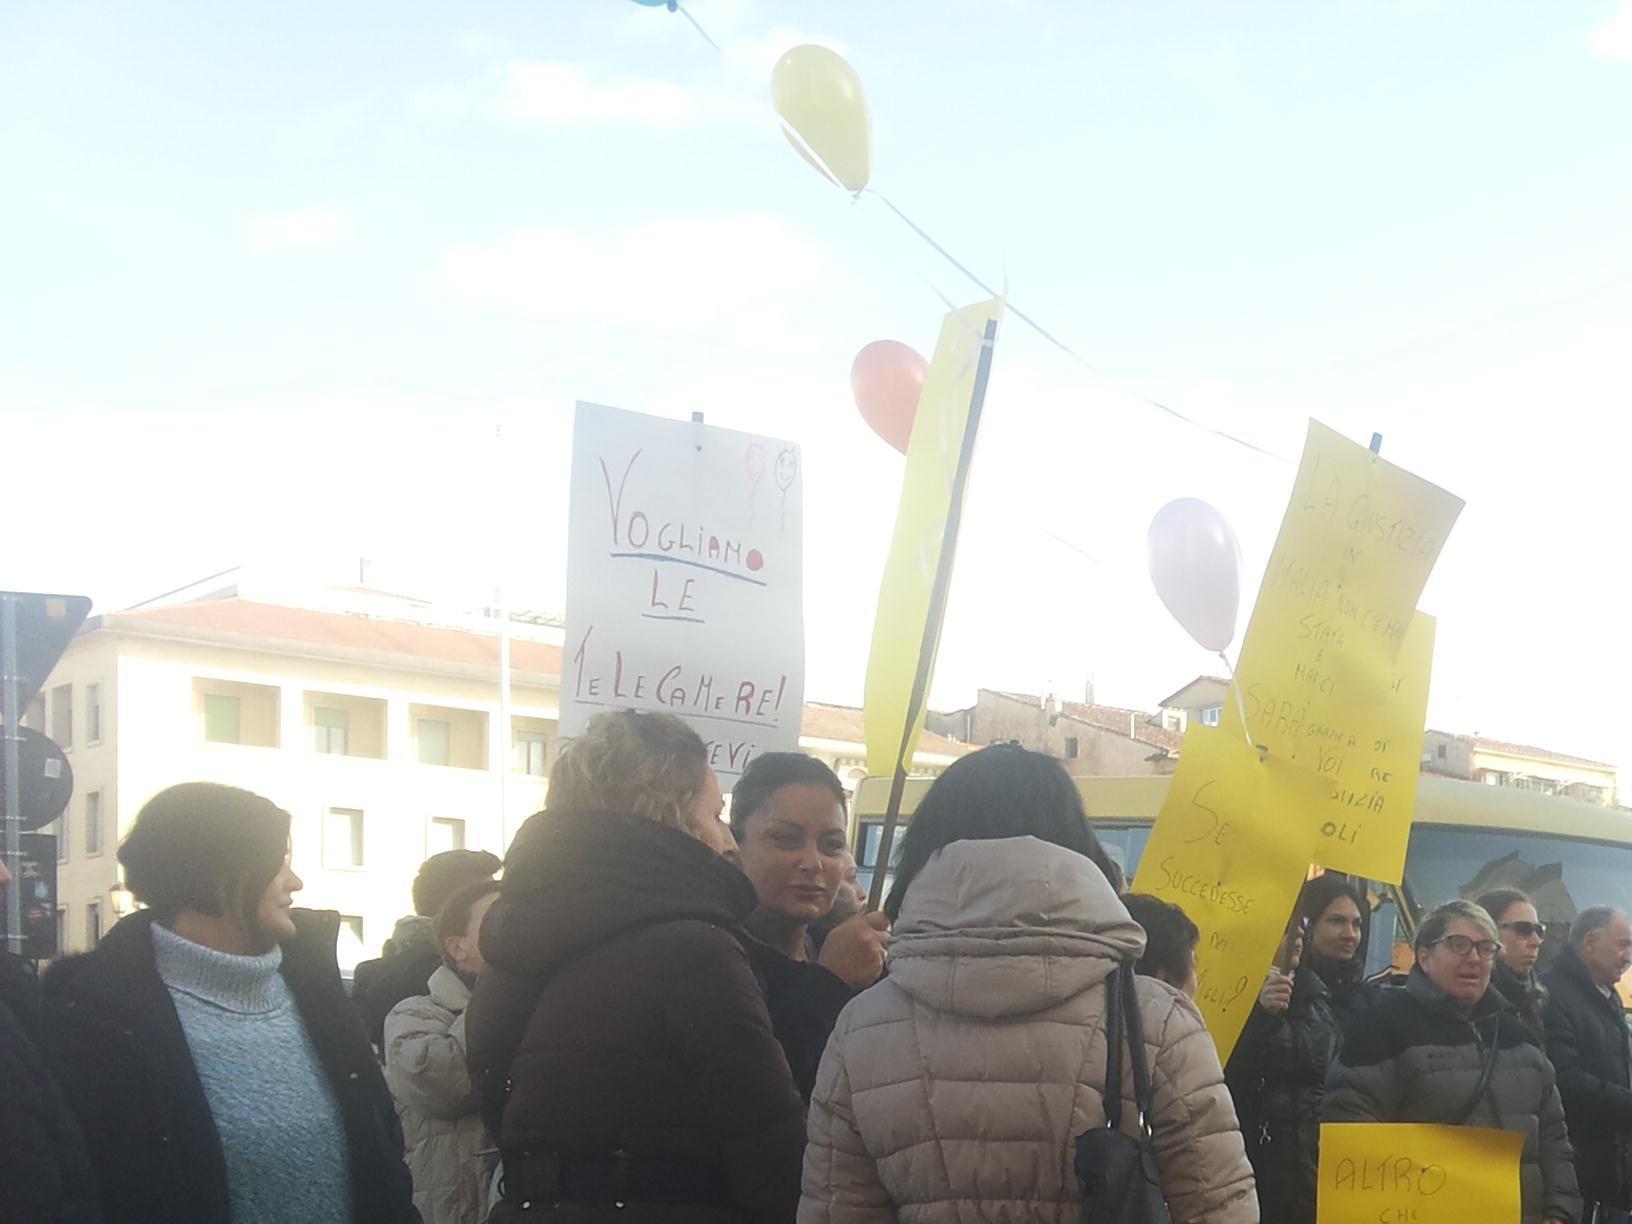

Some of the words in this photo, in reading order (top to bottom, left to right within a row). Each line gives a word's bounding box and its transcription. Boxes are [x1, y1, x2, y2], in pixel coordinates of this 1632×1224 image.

[599, 449, 765, 571] VOGLIAMO
[651, 569, 696, 612] LE
[574, 626, 788, 722] TELECAMERE!
[1156, 856, 1254, 914] SUCCEDESSE
[1335, 1155, 1447, 1196] ALTRO
[1379, 1207, 1418, 1224] CHE
